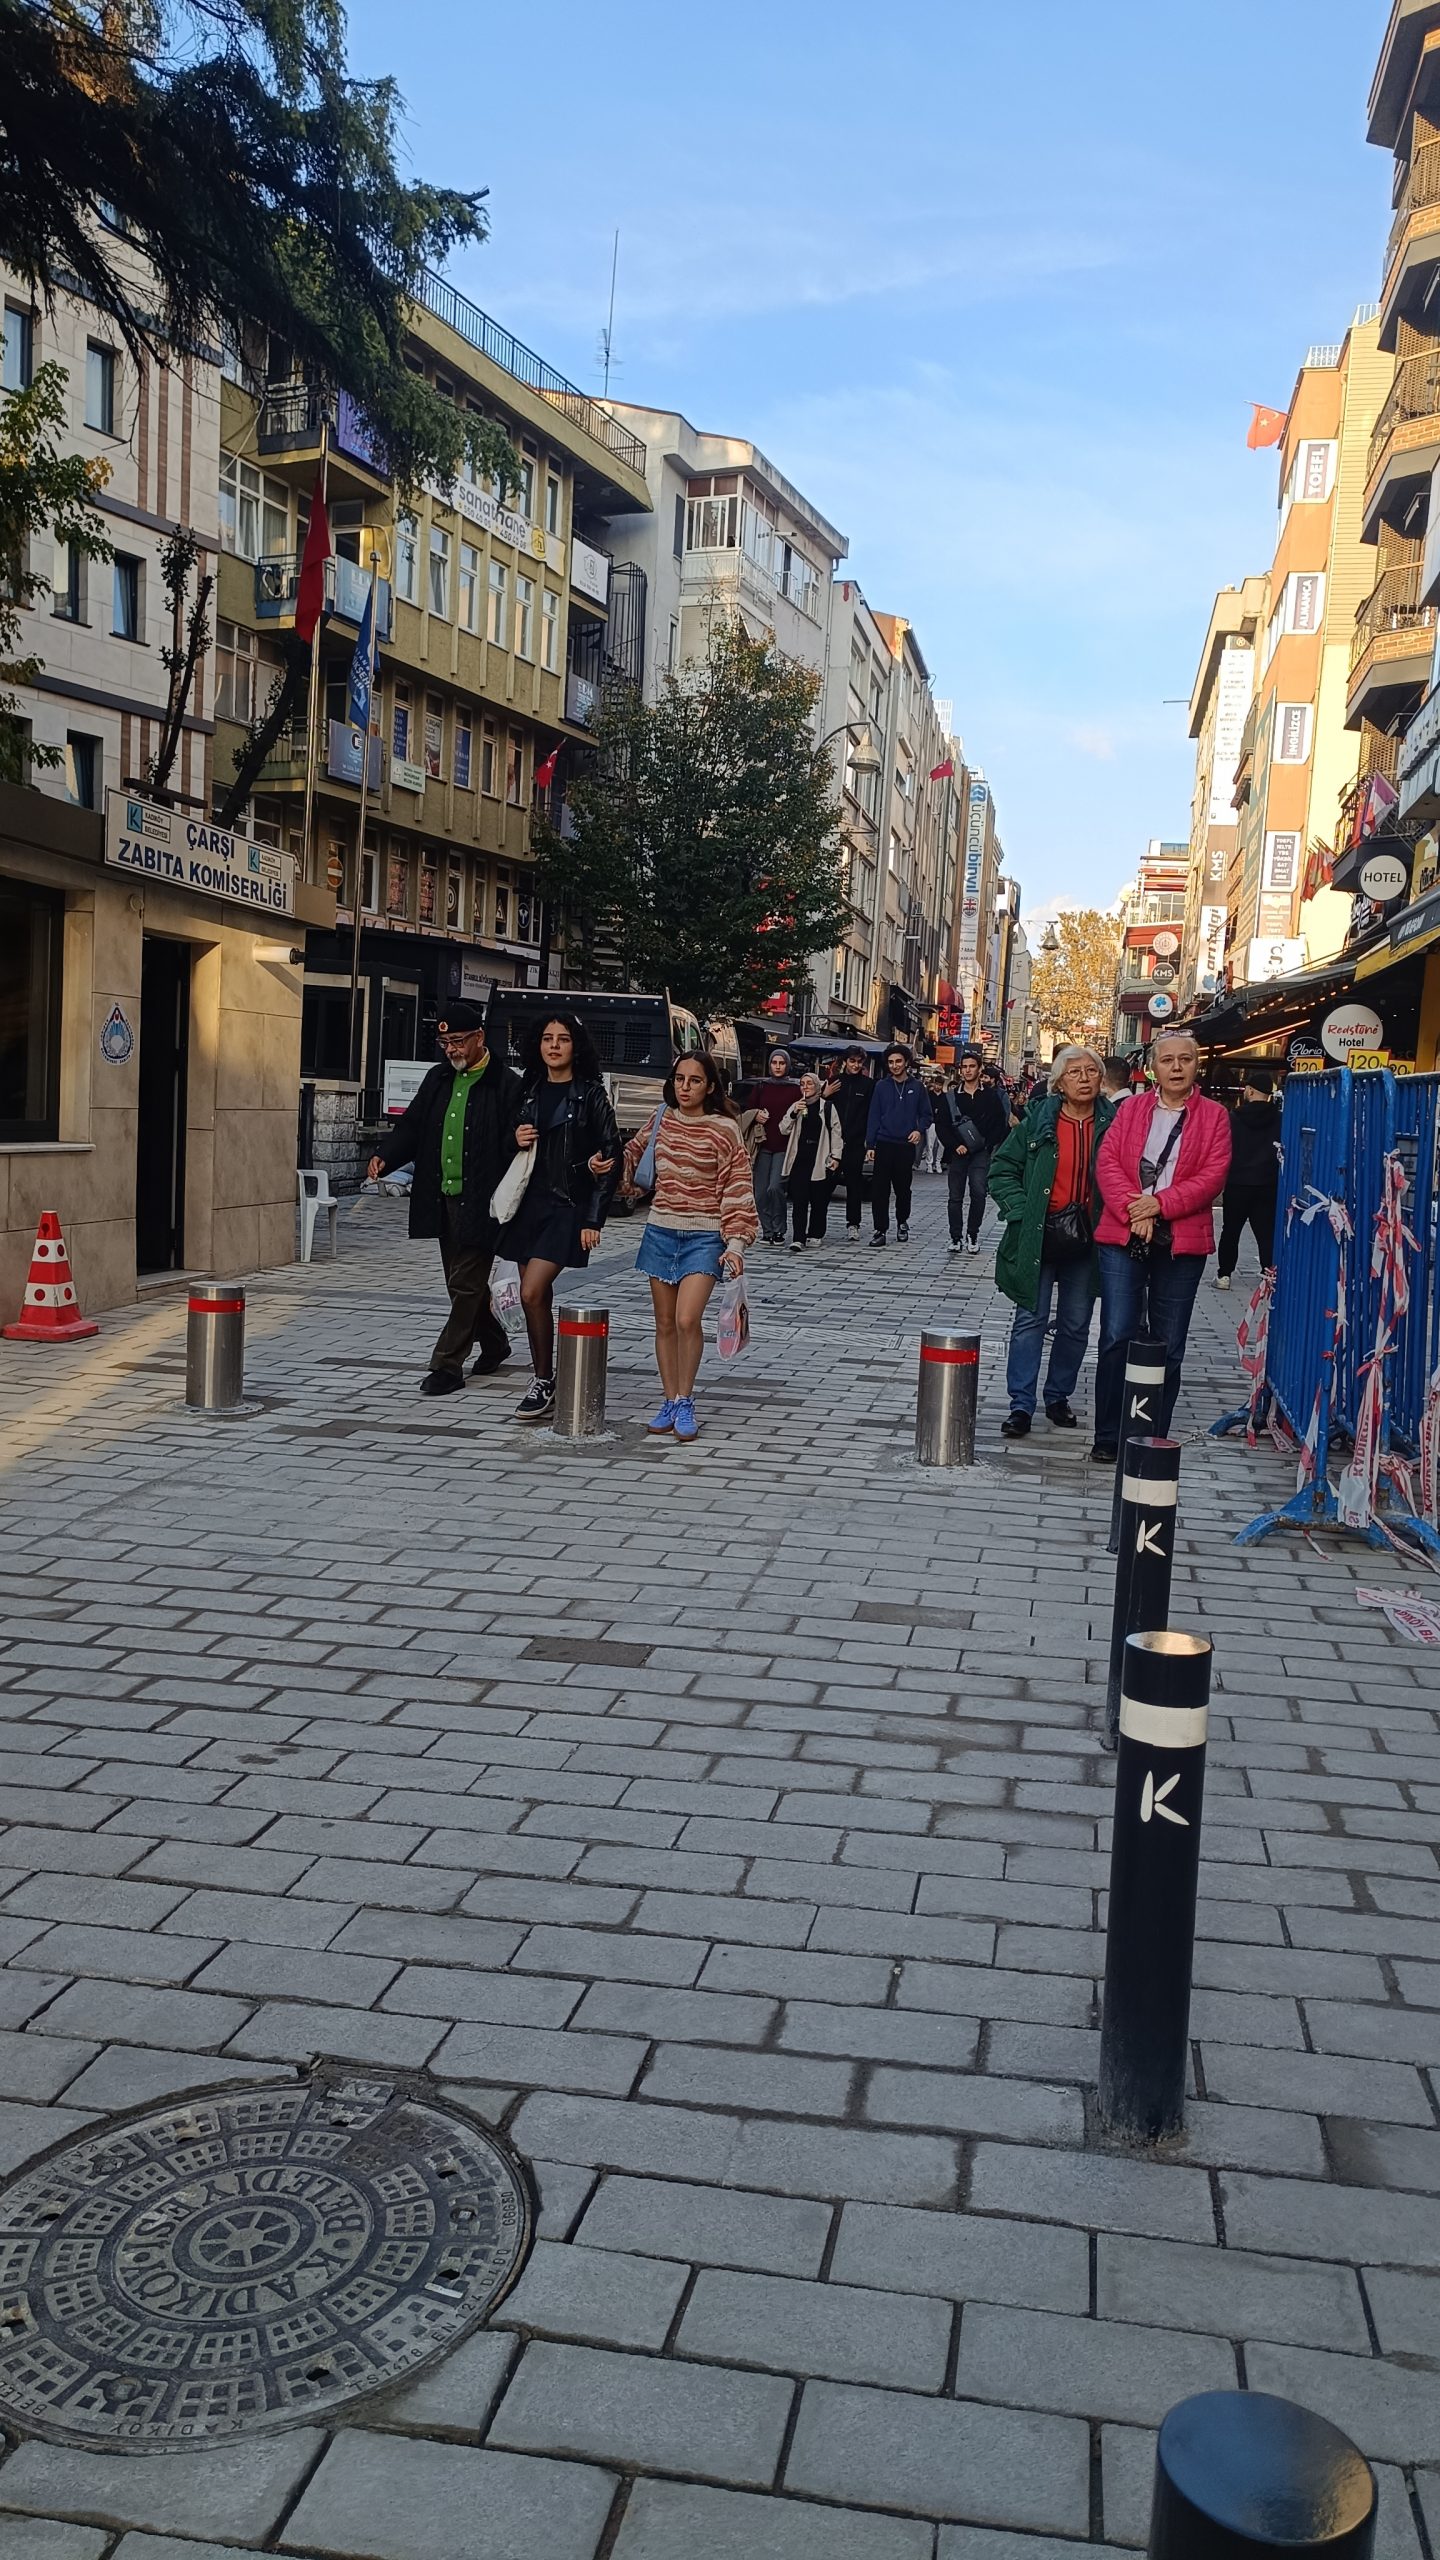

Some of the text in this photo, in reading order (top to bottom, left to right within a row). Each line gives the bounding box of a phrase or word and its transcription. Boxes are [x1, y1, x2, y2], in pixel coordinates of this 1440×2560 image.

[1308, 446, 1326, 496] TOEFL
[187, 823, 235, 861] ÇARŞI
[118, 838, 287, 909] ZABITA KOMİSERLİĞİ
[1364, 871, 1403, 884] HOTEL
[1154, 969, 1173, 978] KMS
[1339, 1038, 1364, 1047] Hotel
[1137, 1520, 1166, 1557] K
[1140, 1770, 1189, 1826] K
[431, 2322, 457, 2342] EN
[110, 2418, 243, 2437] KADIKÖY
